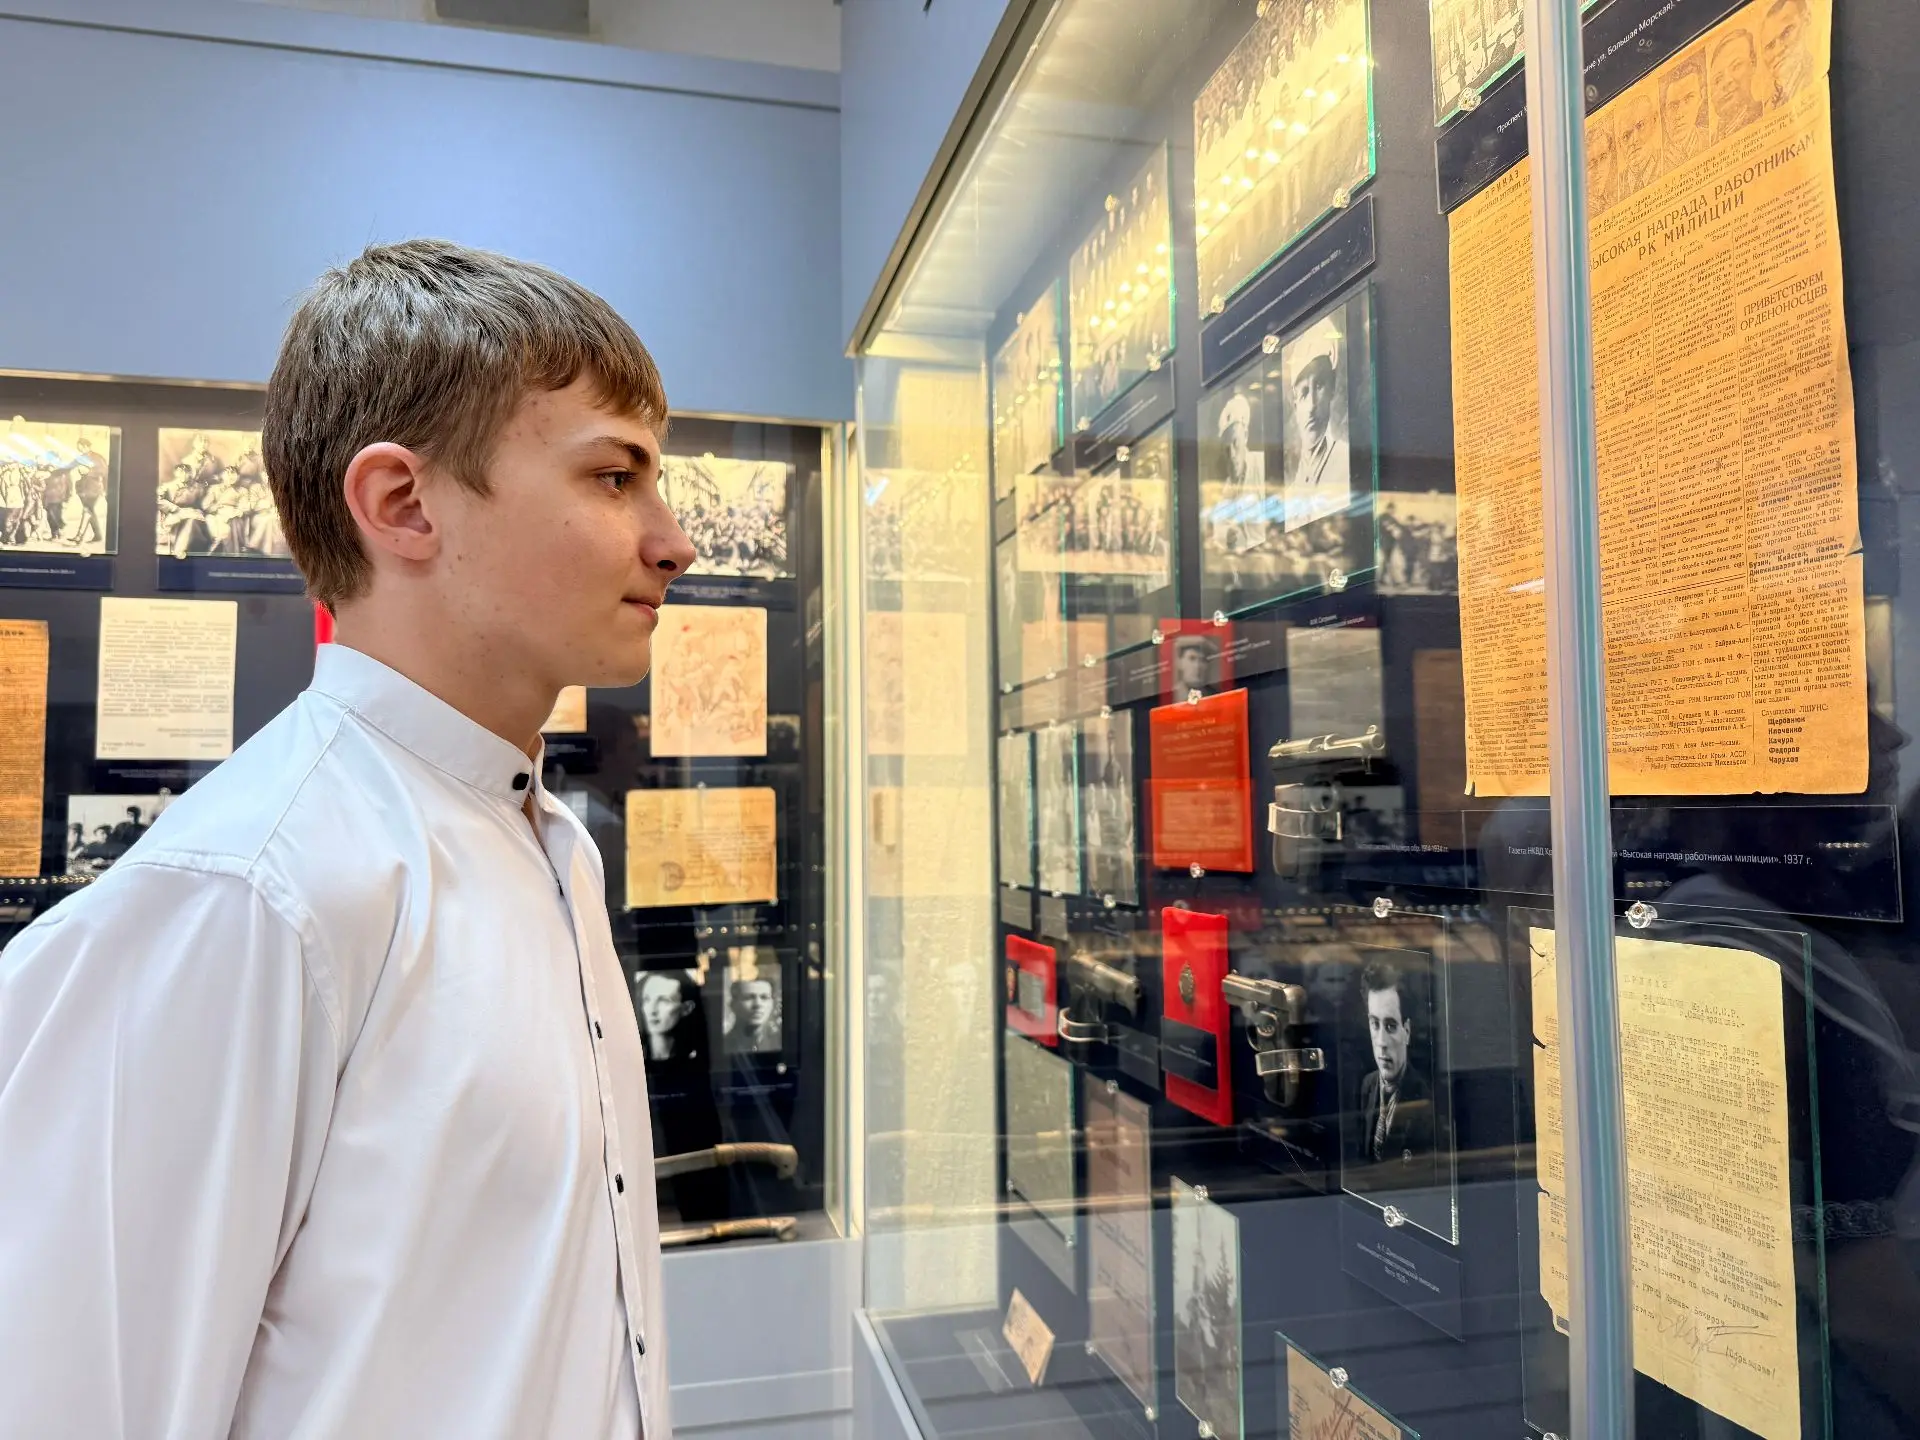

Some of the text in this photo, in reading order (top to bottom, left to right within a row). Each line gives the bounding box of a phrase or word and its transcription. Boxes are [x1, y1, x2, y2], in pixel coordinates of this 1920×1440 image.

[1597, 53, 1607, 66] ул.
[1607, 27, 1638, 56] Большая
[1497, 109, 1524, 134] Проспект
[1646, 193, 1708, 239] НАГРАДА
[1713, 129, 1816, 201] РАБОТНИКАМ
[1638, 190, 1745, 260] РК МИЛИЦИИ
[1740, 283, 1827, 330] ОРДЕНОНОСЦЕВ
[1743, 270, 1823, 316] ПРИВЕТСТВУЕМ
[1768, 746, 1800, 754] Федоров
[1768, 756, 1799, 765] Чарухов
[1508, 846, 1527, 855] Газета
[1527, 847, 1544, 856] НКВД
[1619, 849, 1653, 859] «Высокая
[1653, 851, 1683, 862] награда
[1684, 851, 1733, 863] работникам
[1734, 854, 1782, 865] милиции».
[1783, 854, 1804, 865] 1937
[1805, 856, 1813, 865] г.
